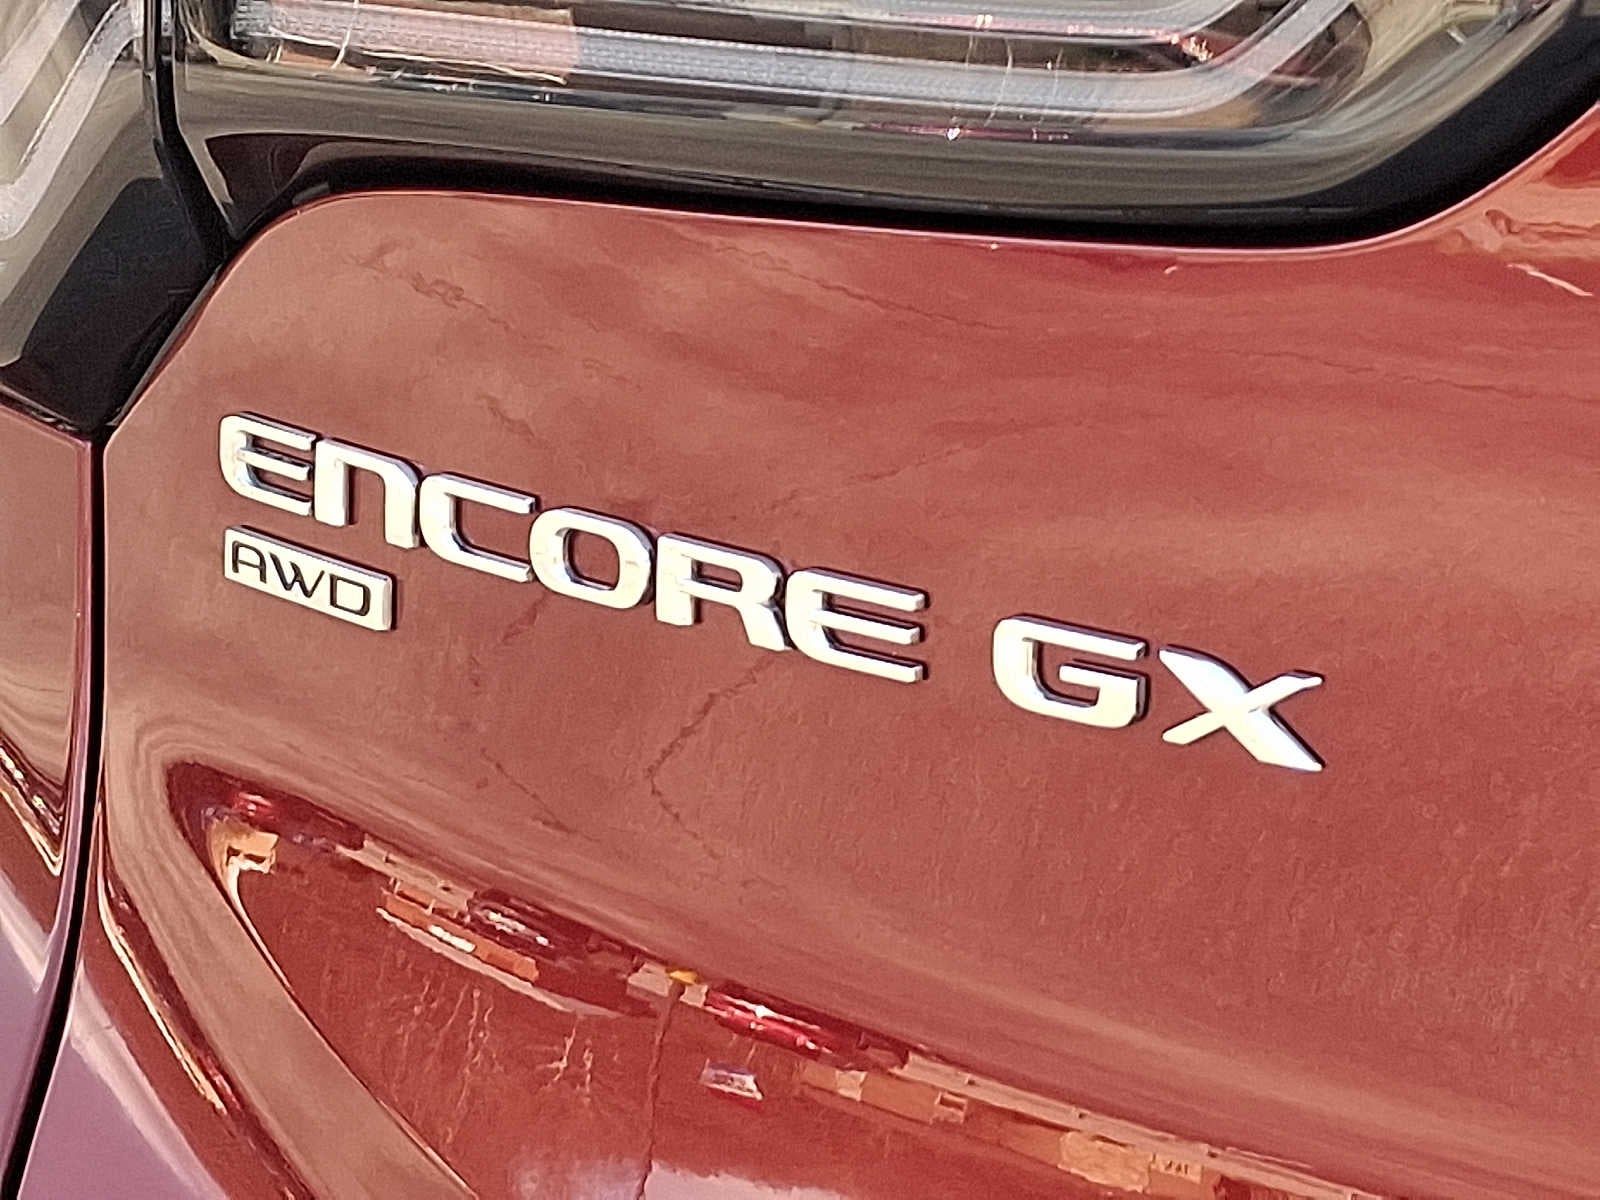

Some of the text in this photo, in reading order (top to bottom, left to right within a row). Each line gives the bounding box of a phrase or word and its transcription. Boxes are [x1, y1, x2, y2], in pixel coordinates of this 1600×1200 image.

[219, 412, 1324, 772] ENCORE GX
[231, 540, 372, 617] AWD
